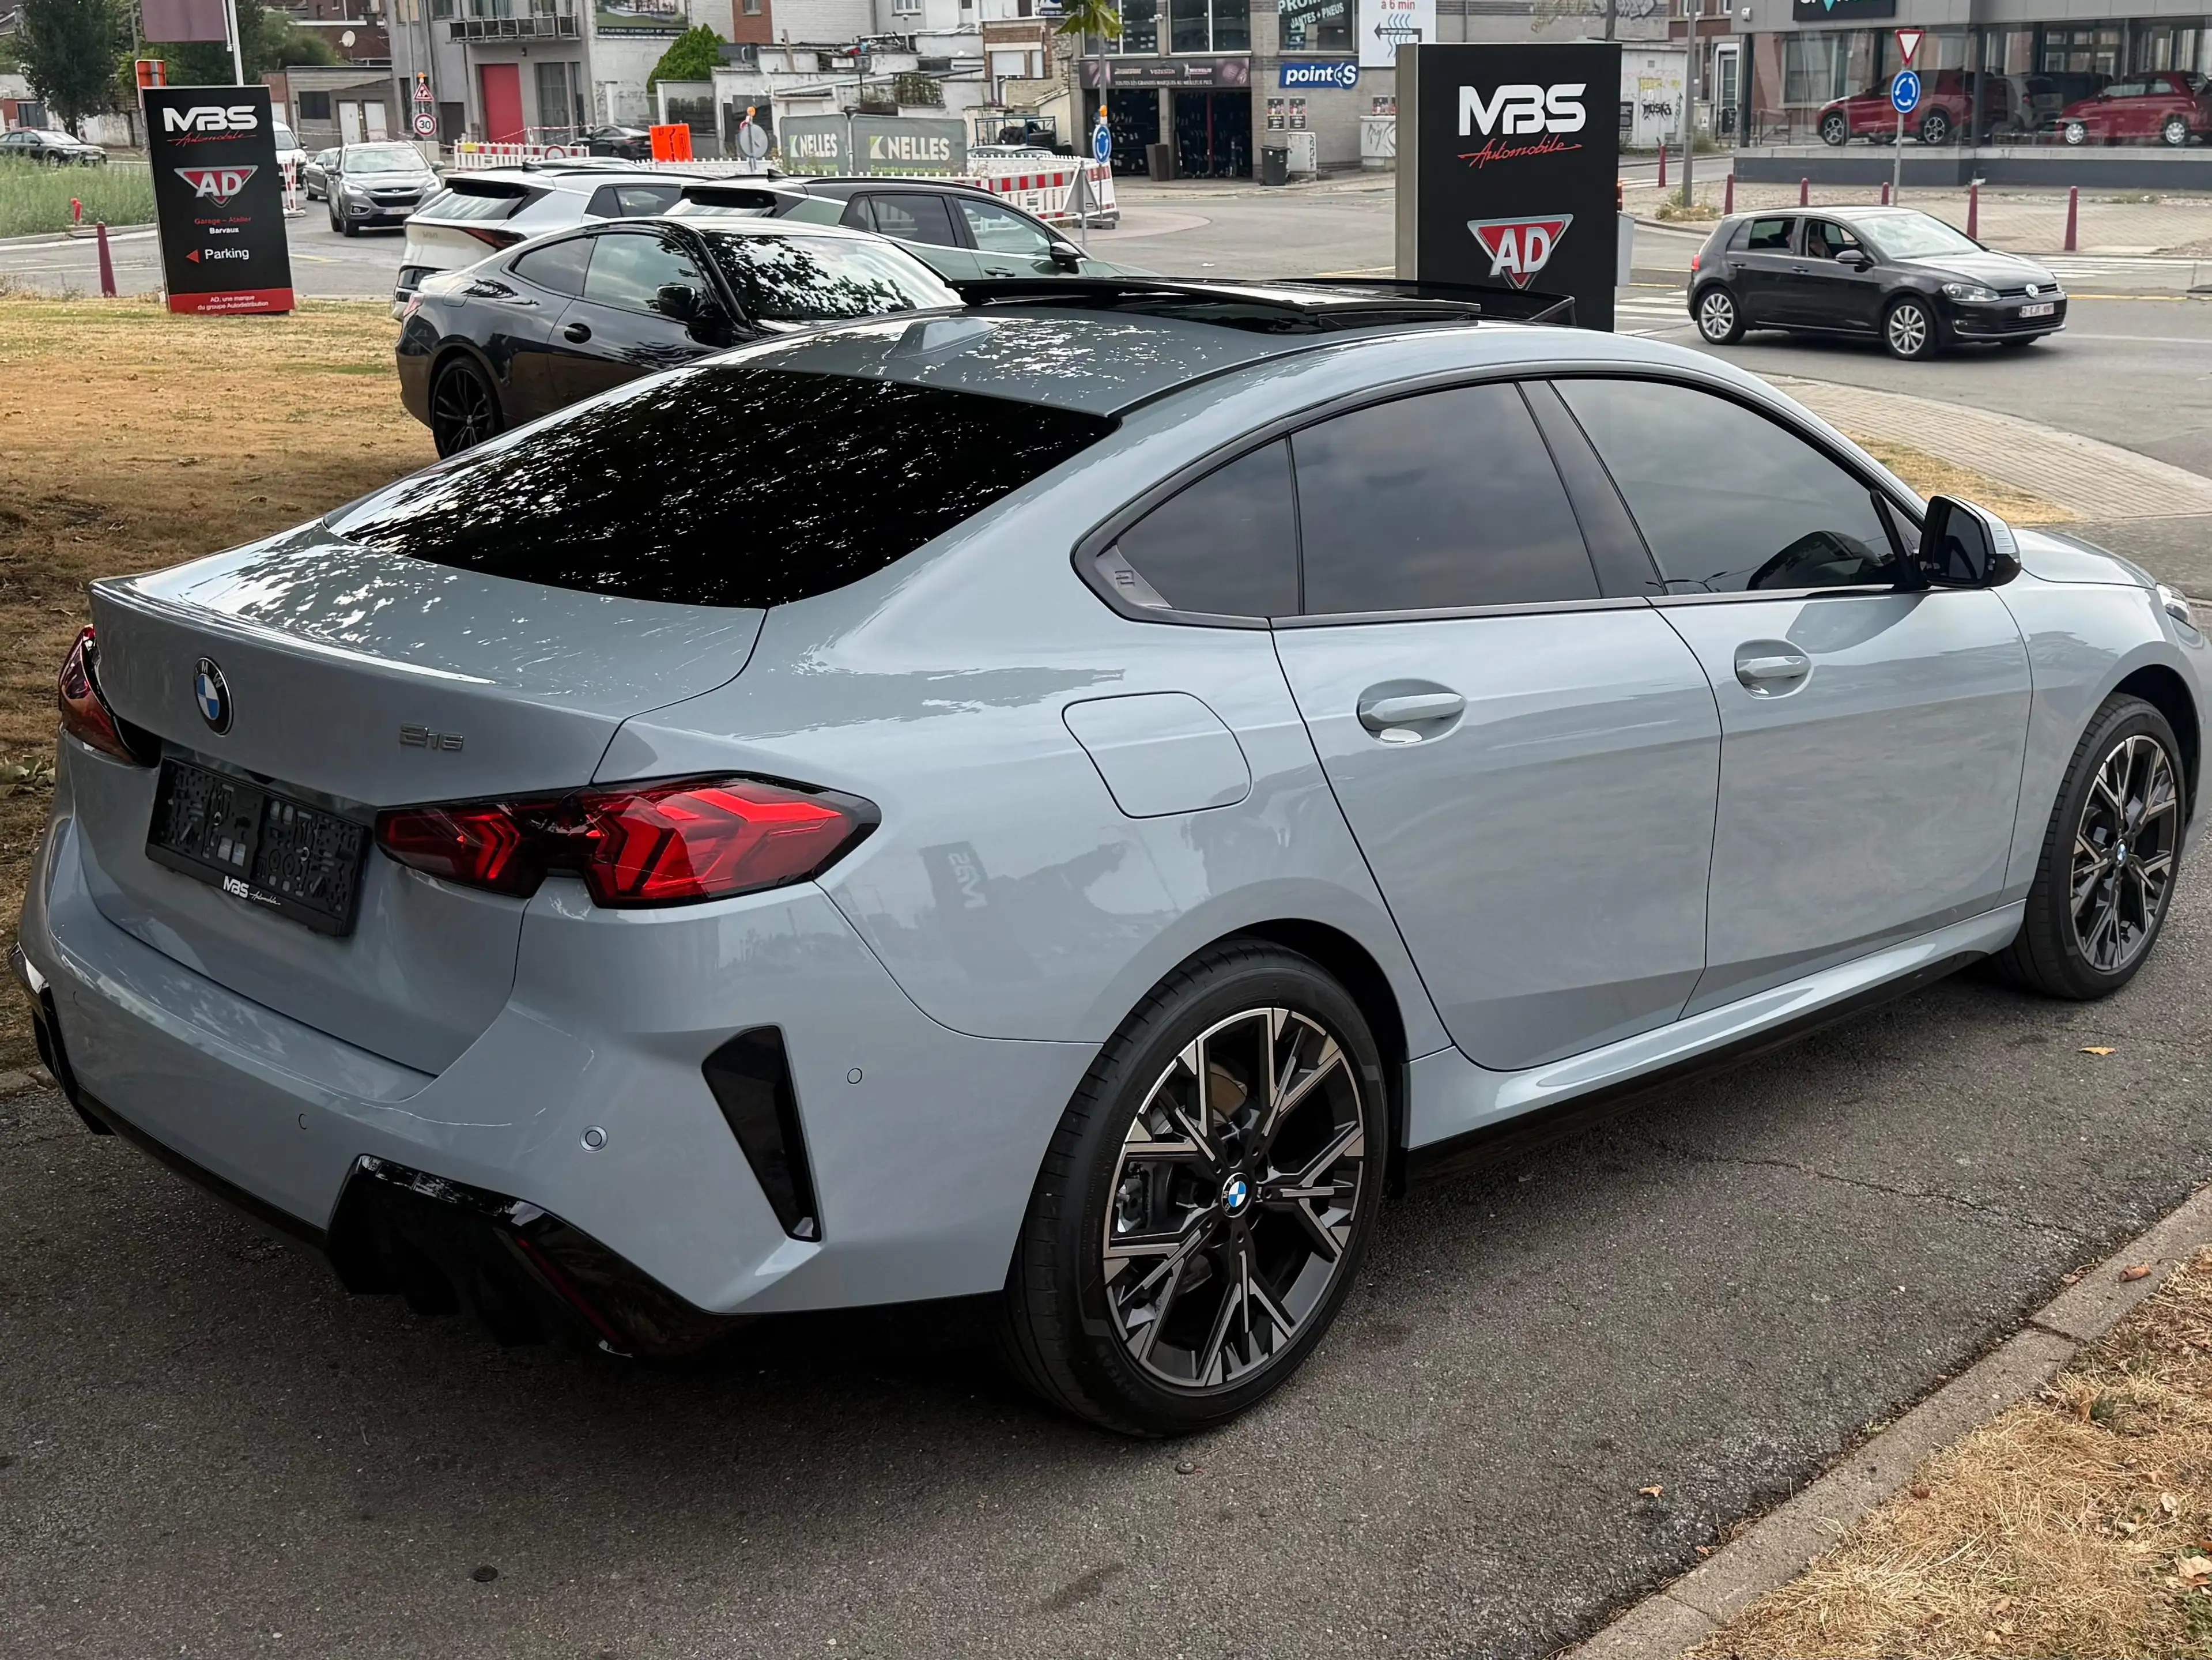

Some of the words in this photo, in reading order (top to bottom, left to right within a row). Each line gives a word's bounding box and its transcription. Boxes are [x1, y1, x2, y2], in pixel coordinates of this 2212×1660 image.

[1278, 0, 1322, 15] PRO
[1290, 12, 1316, 29] JANTES
[1322, 2, 1344, 18] PNEUS
[1398, 0, 1415, 10] min
[163, 105, 258, 131] MBS
[1459, 84, 1587, 136] MBS
[419, 119, 431, 129] 30
[800, 133, 837, 158] NELLES
[888, 136, 950, 161] NELLES
[1458, 133, 1583, 169] Automobile
[195, 172, 243, 198] AD
[194, 217, 221, 225] Garage
[205, 248, 250, 260] Parking
[1489, 226, 1551, 278] AD
[223, 876, 249, 898] MBS
